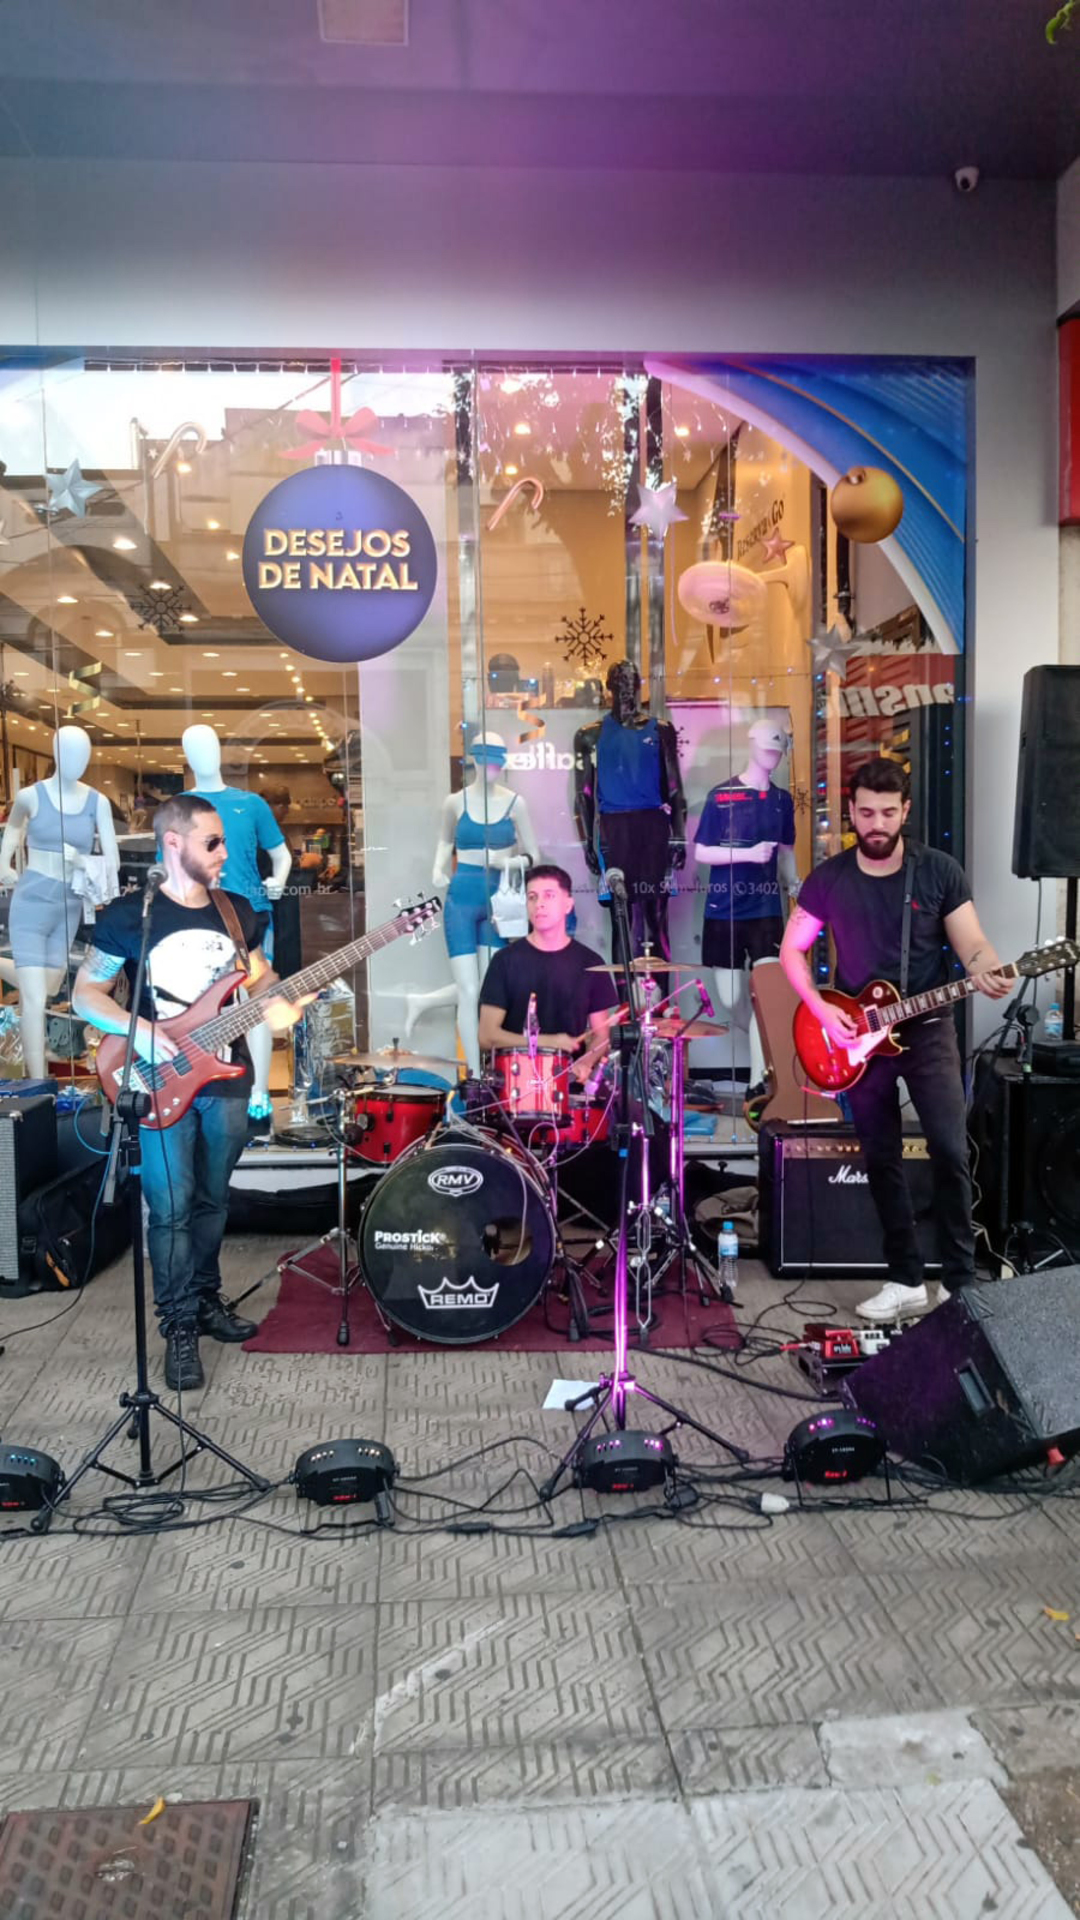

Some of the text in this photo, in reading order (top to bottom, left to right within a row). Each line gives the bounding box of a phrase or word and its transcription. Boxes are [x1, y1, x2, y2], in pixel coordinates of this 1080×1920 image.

[264, 528, 411, 558] DESEJOS
[258, 561, 419, 591] DE NATAL
[633, 881, 655, 894] 10x
[437, 1174, 476, 1186] RMV
[828, 1164, 869, 1184] Mars
[430, 1292, 488, 1306] REMO
